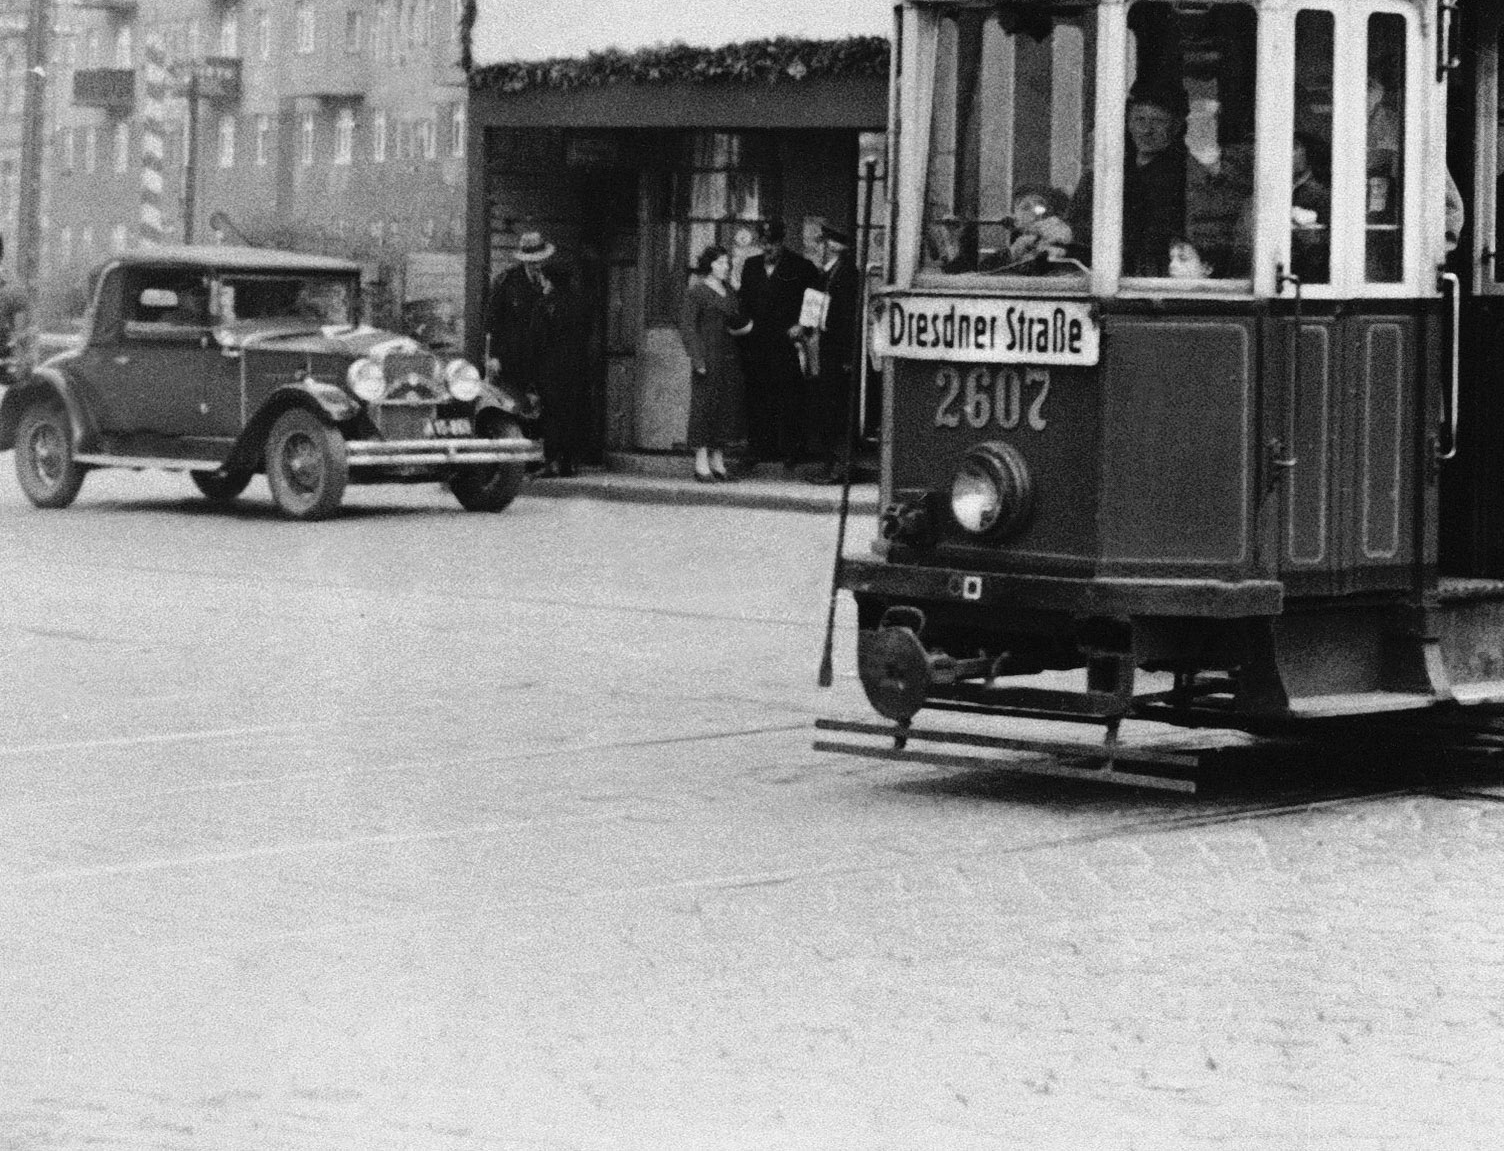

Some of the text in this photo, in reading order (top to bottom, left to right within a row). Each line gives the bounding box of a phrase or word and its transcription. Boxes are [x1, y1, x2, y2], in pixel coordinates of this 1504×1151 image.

[889, 302, 1083, 354] Dresdner Straße
[934, 367, 1051, 432] 2607
